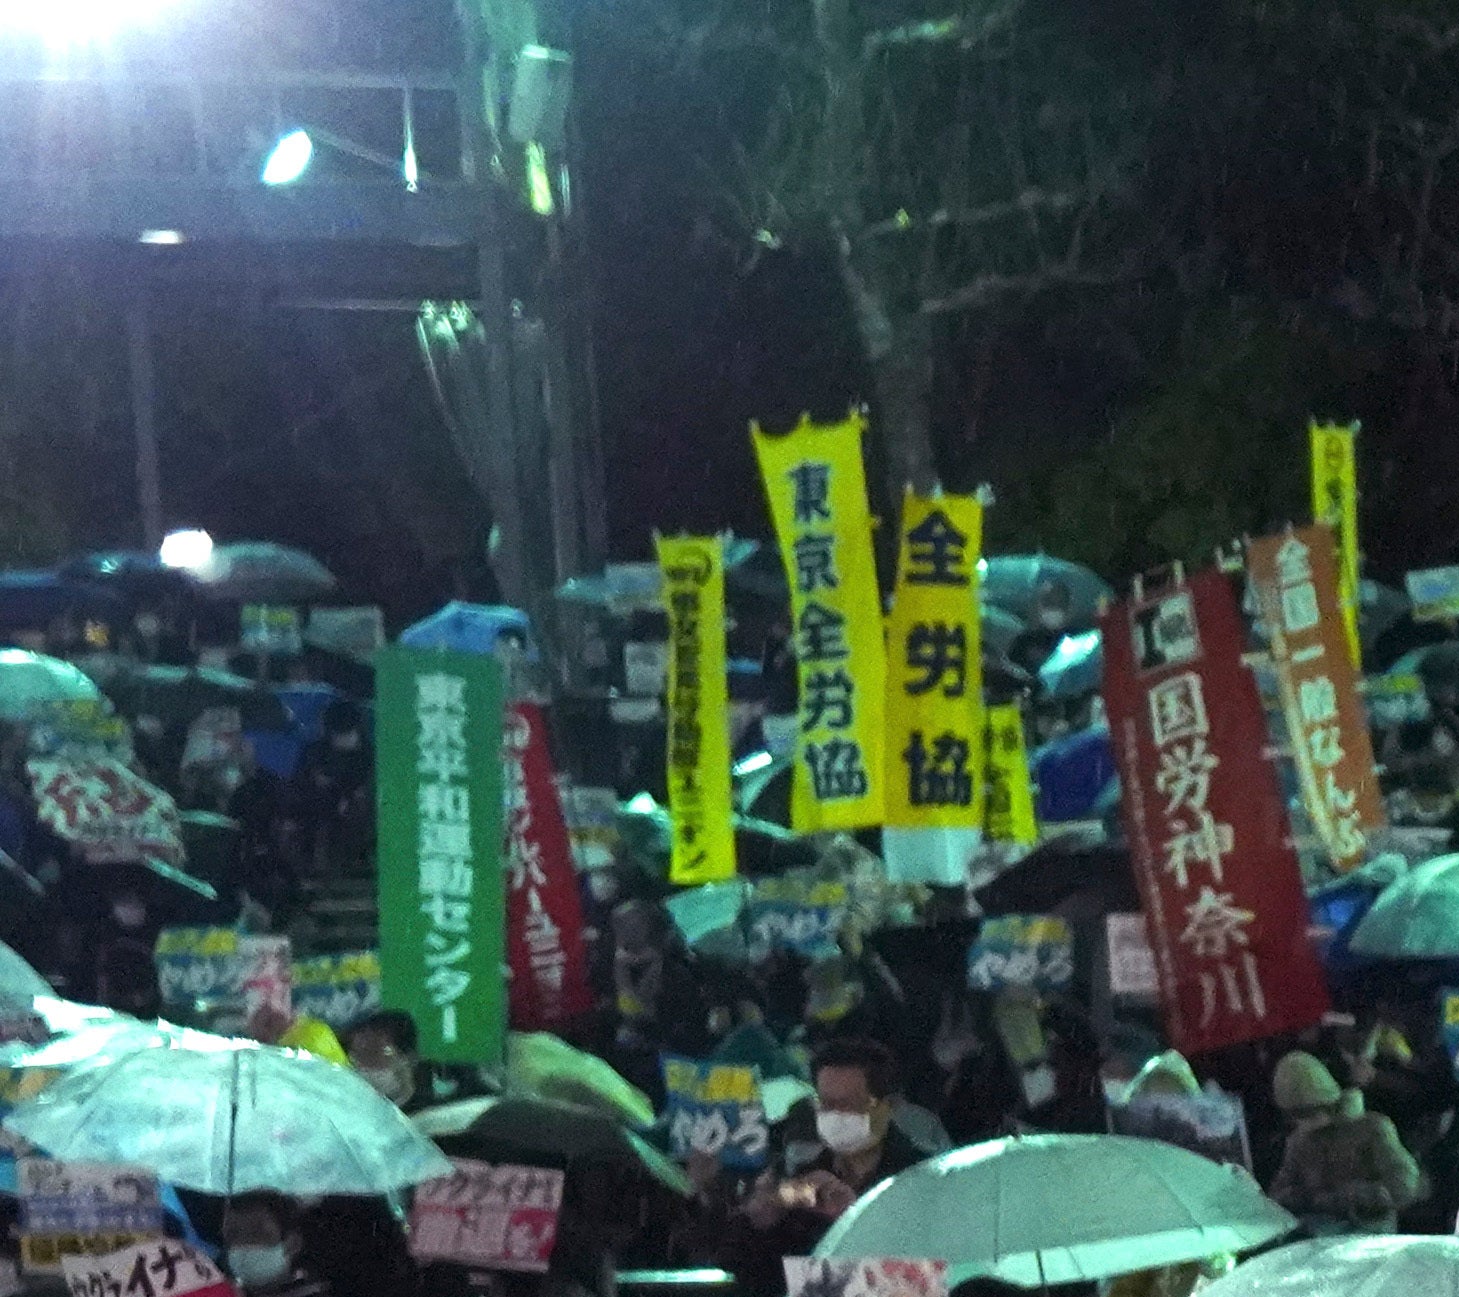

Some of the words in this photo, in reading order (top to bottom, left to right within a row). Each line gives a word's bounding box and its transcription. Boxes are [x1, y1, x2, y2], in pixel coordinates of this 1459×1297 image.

[790, 456, 869, 802] 東京全労協
[901, 508, 976, 808] 全労協
[1149, 672, 1266, 1024] 国労神奈川
